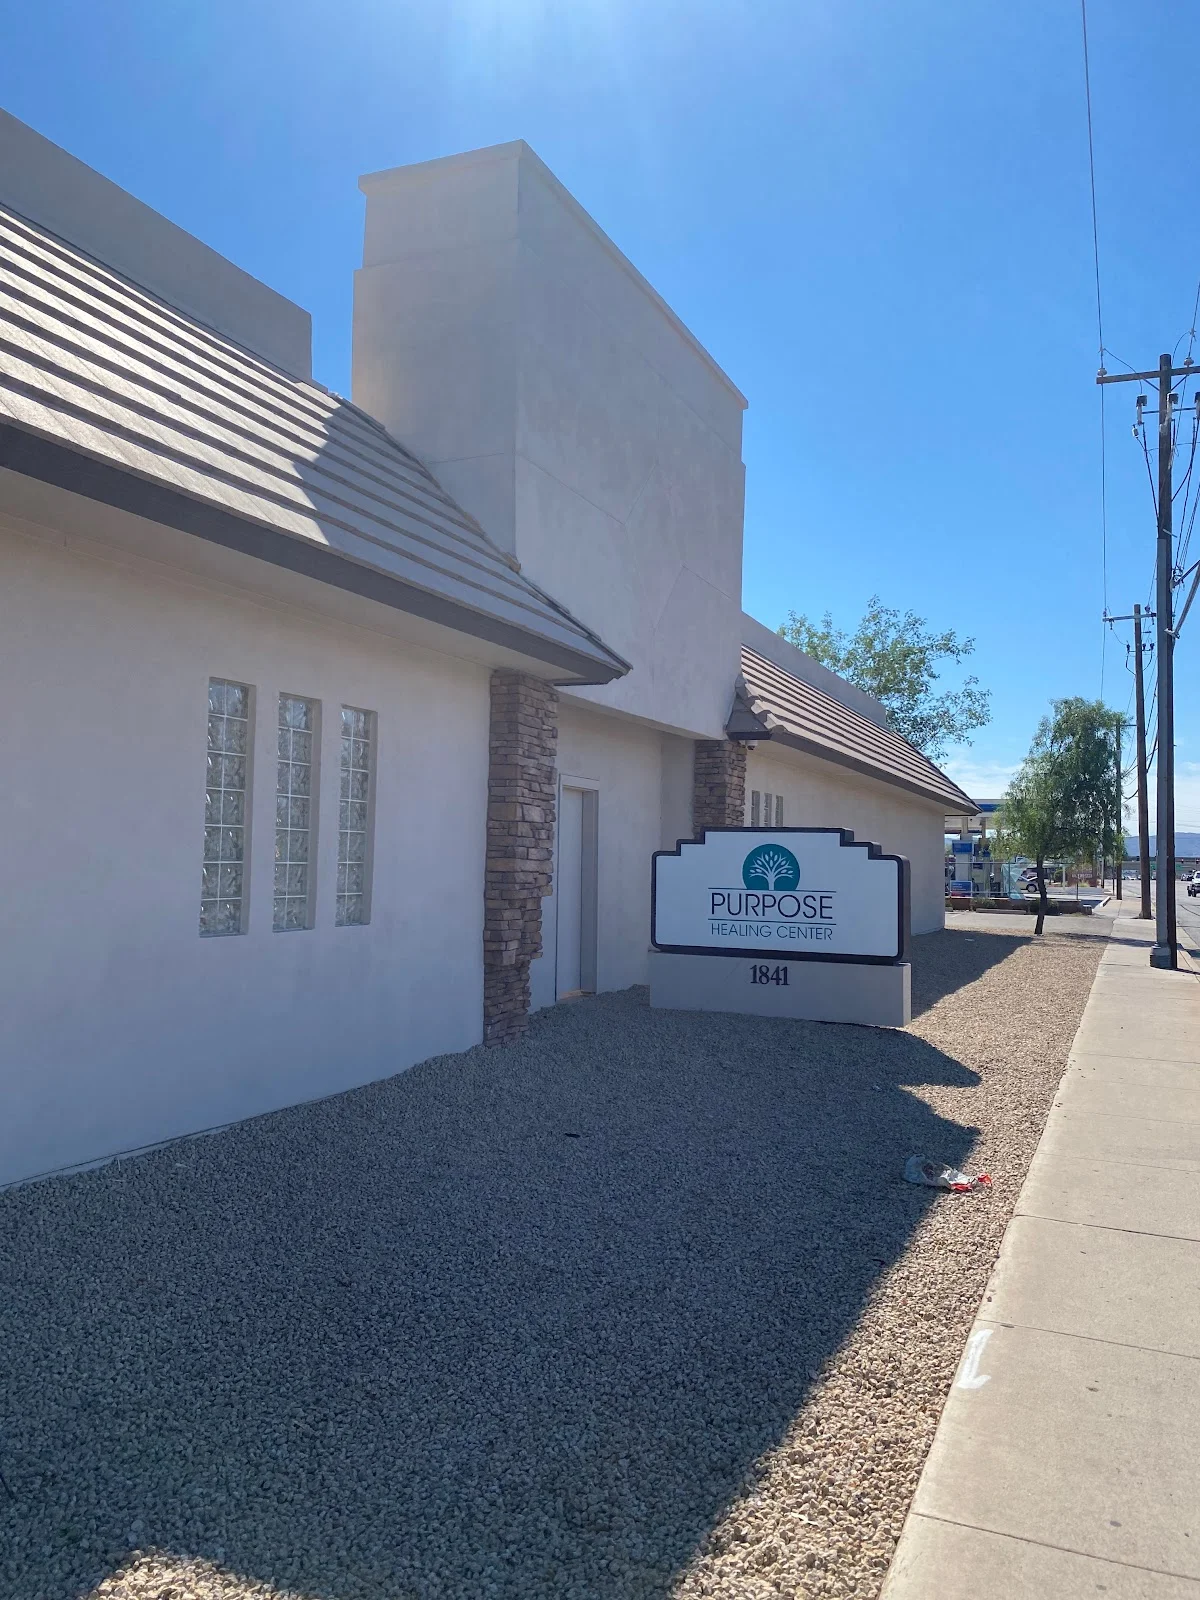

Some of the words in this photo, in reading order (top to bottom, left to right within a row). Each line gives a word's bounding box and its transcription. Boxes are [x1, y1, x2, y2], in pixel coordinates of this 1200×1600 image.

[711, 892, 833, 920] PURPOSE
[711, 923, 772, 938] HEALING
[776, 925, 833, 940] CENTER
[749, 964, 790, 986] 1841
